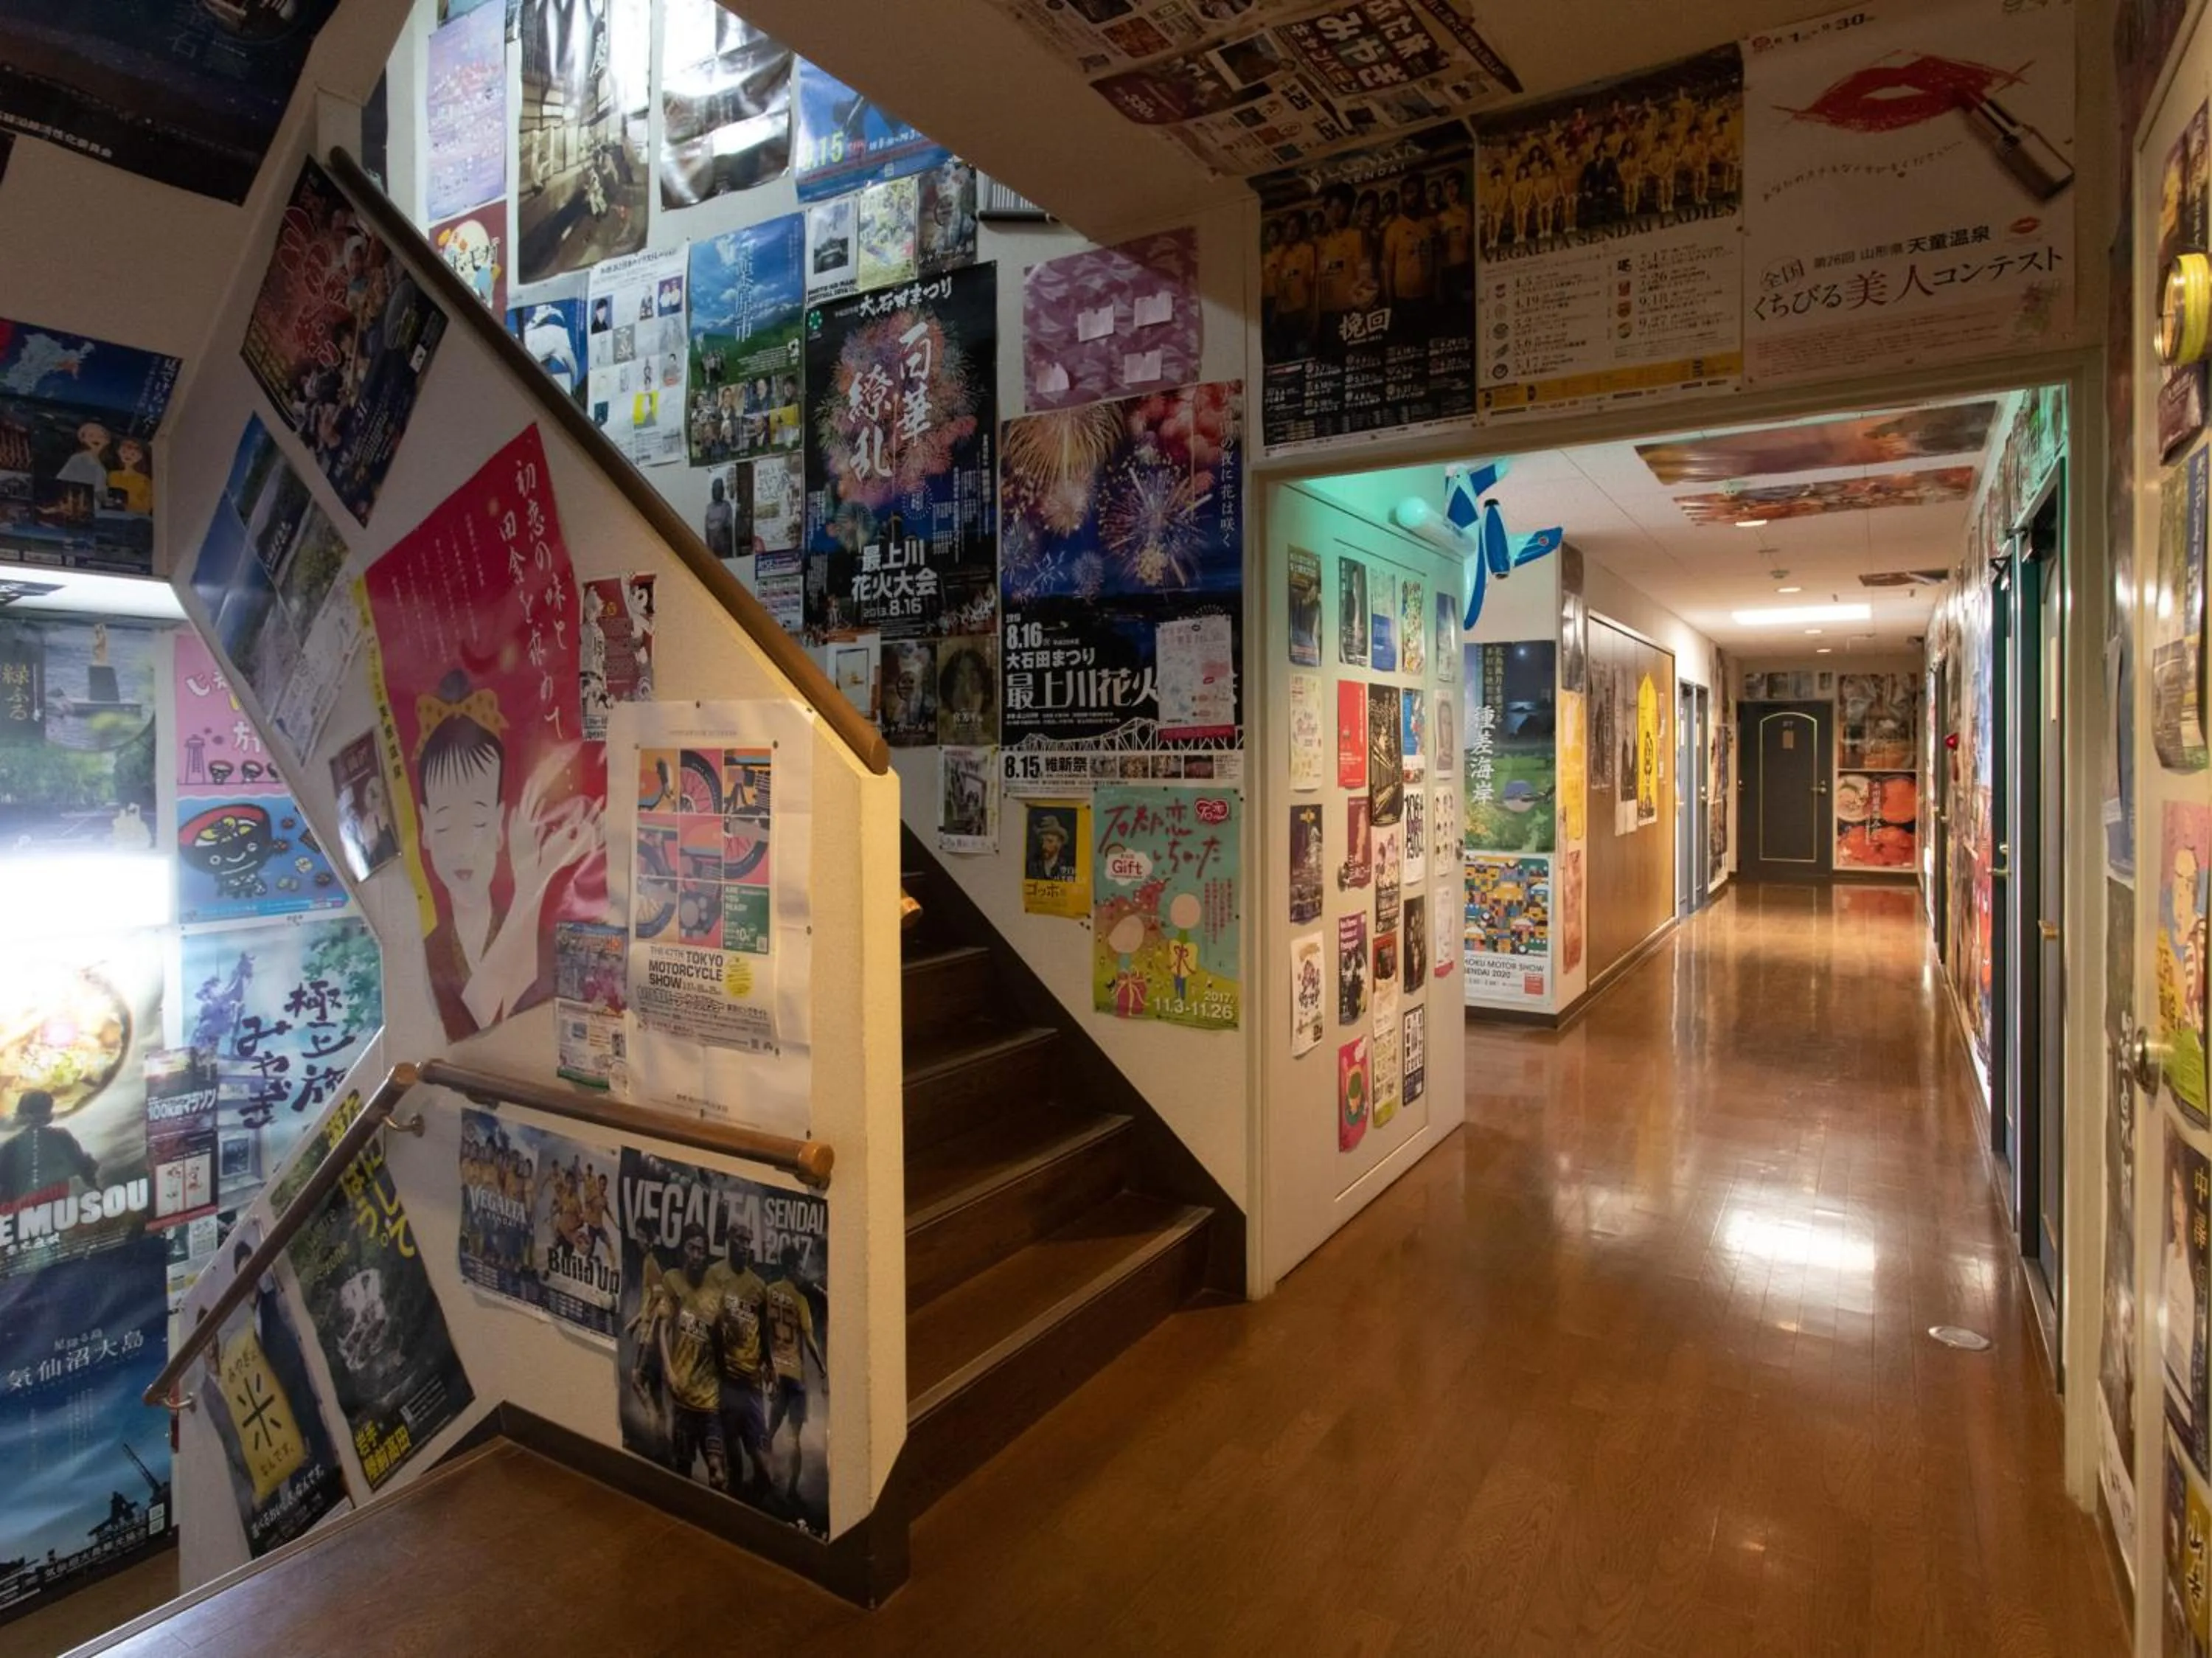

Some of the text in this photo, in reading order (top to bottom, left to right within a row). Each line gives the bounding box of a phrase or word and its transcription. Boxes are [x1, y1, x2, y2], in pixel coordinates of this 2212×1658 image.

[1907, 224, 1992, 254] 天童温泉
[1750, 246, 2064, 322] くちびる美人コンテスト
[1763, 258, 1805, 288] 全国
[859, 277, 953, 317] 大石田まつり
[1338, 308, 1391, 341] 挽回
[861, 539, 926, 572] 最上川
[851, 569, 939, 603] 花火大会
[1006, 622, 1042, 650] 8.16
[1006, 647, 1096, 670] 大石田まつり
[1006, 666, 1161, 711] 最上川花火
[1004, 755, 1089, 779] 8.15 維新祭
[1111, 859, 1144, 876] Gift
[648, 960, 723, 982] MOTORCYCLE
[686, 950, 723, 968] TOKYO
[1487, 960, 1517, 970] MOTOR
[648, 973, 682, 989] SHOW
[237, 1016, 293, 1130] みやぎ
[18, 1177, 148, 1242] MUSOU
[468, 1184, 527, 1225] VEGALTA
[623, 1177, 824, 1263] VEGALTA SENDAI
[7, 1329, 145, 1391] 気仙沼大島
[242, 1372, 282, 1451] 米
